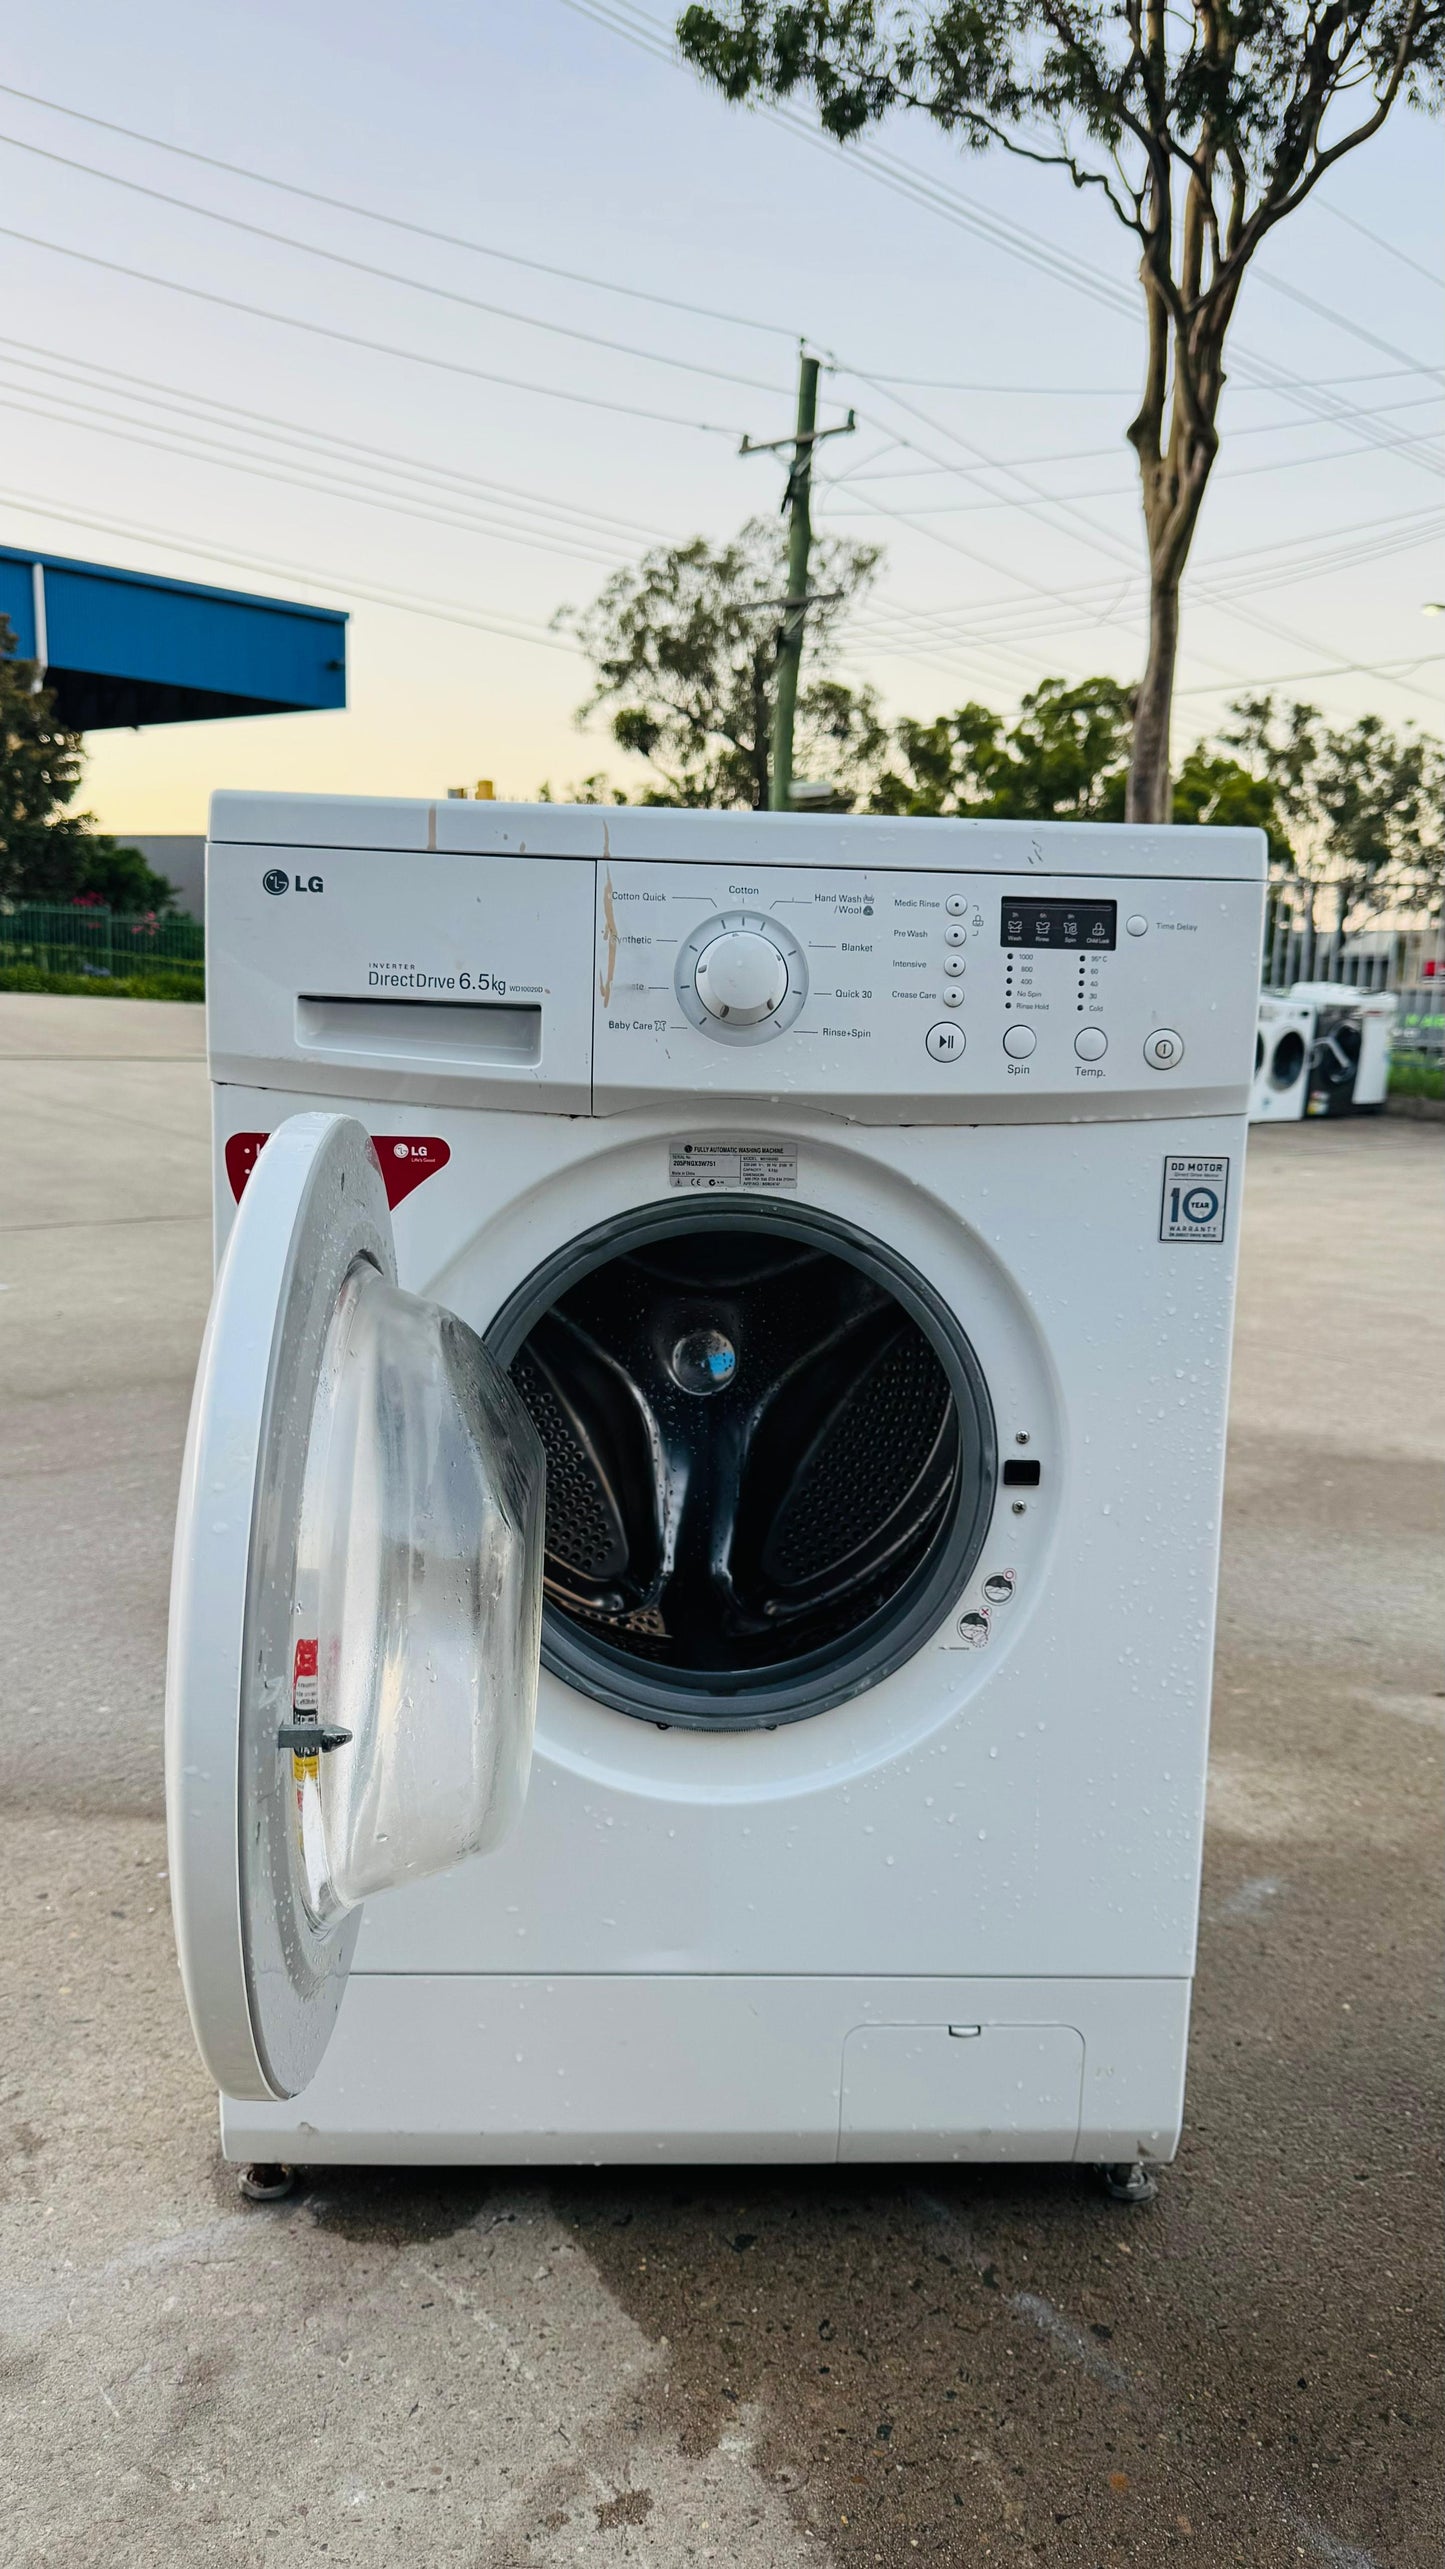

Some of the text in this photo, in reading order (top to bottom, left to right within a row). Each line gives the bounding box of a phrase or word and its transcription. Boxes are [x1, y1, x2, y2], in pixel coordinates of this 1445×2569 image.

[295, 875, 324, 893] LG
[728, 885, 759, 895] Cotton
[611, 891, 667, 902] Cotton Quick
[814, 893, 862, 904] Hand Wash
[894, 899, 941, 909] Medic Rinse
[833, 905, 862, 915] /Wool
[1156, 922, 1198, 932] Time Delay
[893, 929, 929, 939] Pre Wash
[841, 942, 873, 952] Blanket
[1019, 953, 1034, 961] 1000
[368, 962, 416, 971] INVERTER
[892, 960, 927, 969] Intensive
[1021, 965, 1033, 973] 800
[835, 988, 873, 999] Quick 30
[891, 990, 937, 999] Crease Care
[1027, 991, 1042, 999] Spin
[1016, 1002, 1050, 1011] Rinse Hold
[608, 1019, 653, 1031] Baby Care
[822, 1027, 872, 1039] Rinse+Spin
[1007, 1063, 1031, 1076] Spin
[1074, 1066, 1106, 1079] Temp.
[411, 1146, 428, 1157] LG
[1171, 1162, 1223, 1172] DD MOTOR
[1170, 1187, 1219, 1224] 10
[1169, 1225, 1217, 1233] WARRANTY
